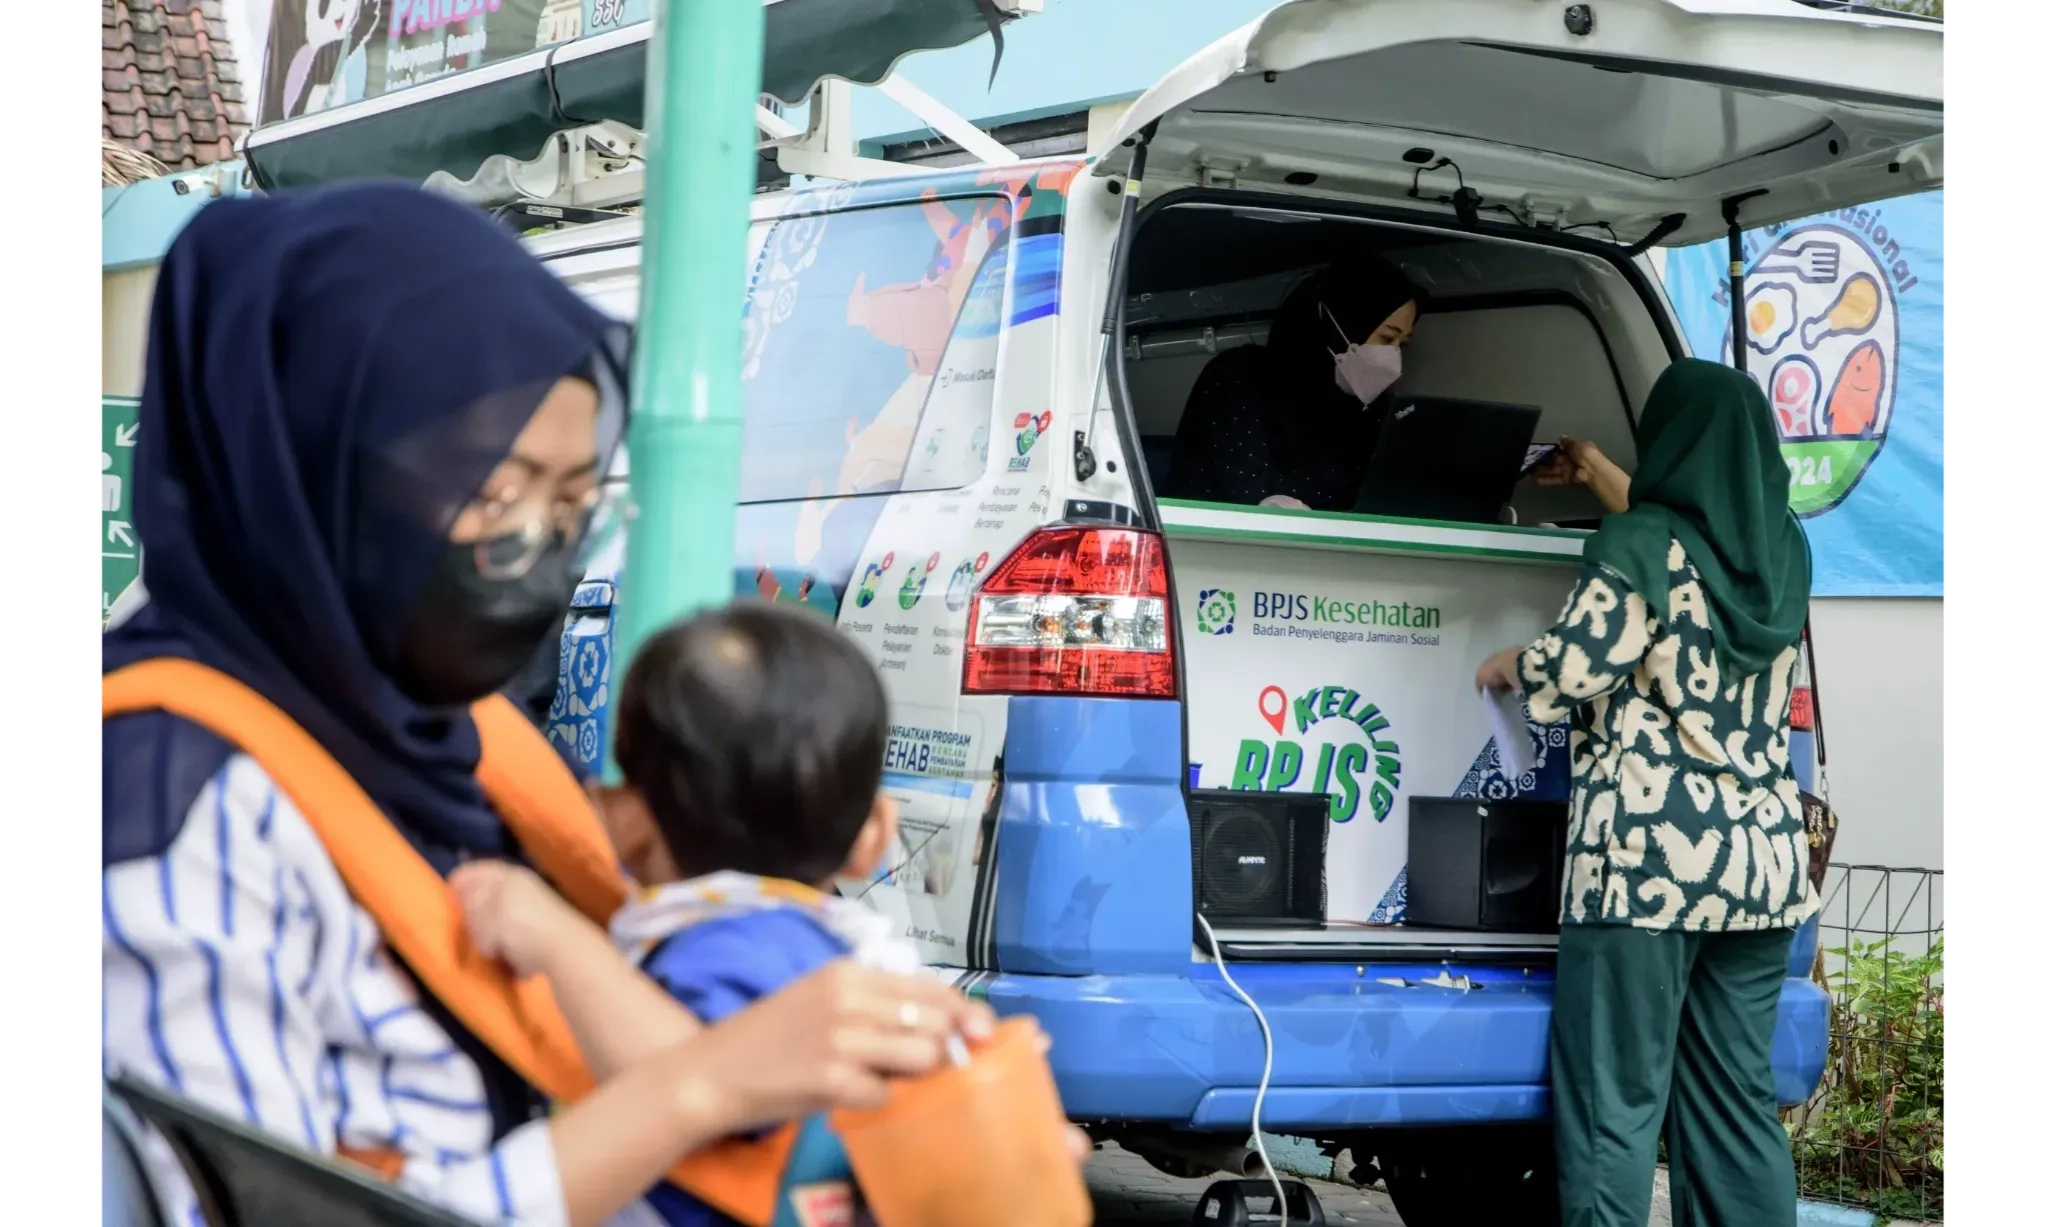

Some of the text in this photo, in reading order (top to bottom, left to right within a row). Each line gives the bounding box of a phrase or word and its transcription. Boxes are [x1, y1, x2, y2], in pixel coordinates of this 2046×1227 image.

[389, 0, 501, 37] PAND
[1784, 455, 1833, 486] 024
[1253, 591, 1440, 629] BPJS Kesehatan
[1253, 623, 1440, 646] Badan Penyelenggara Jaminan Sosial
[888, 725, 972, 746] NFAATKAN PROGRAM
[885, 739, 930, 772] EHAB
[1293, 685, 1401, 823] KELILING
